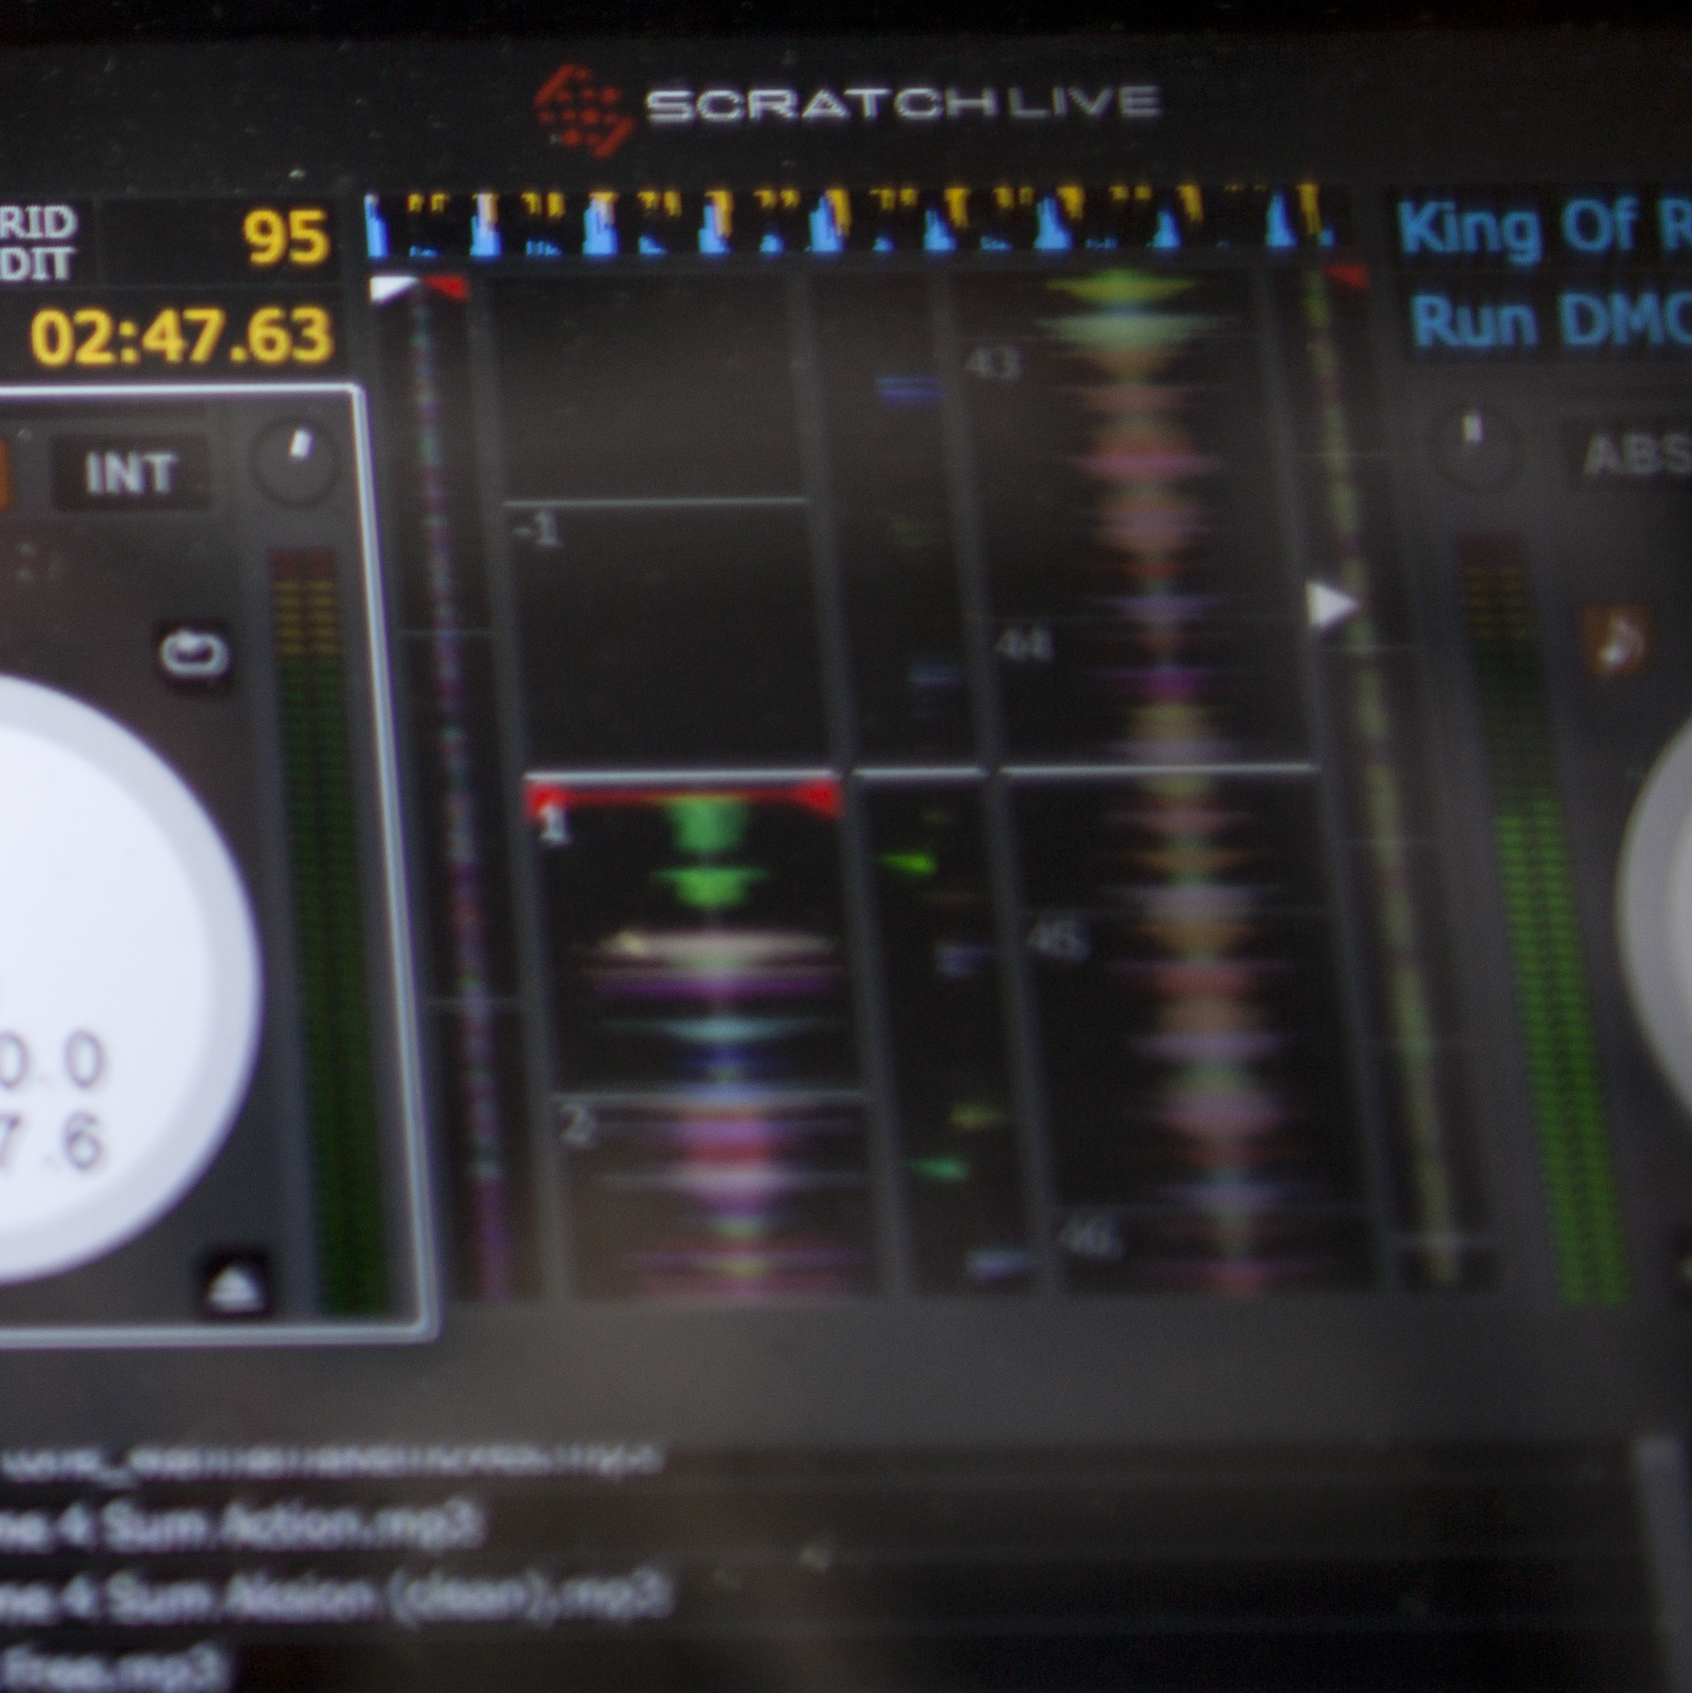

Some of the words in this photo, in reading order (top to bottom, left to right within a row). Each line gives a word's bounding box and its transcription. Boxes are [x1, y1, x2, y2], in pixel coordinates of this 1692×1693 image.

[243, 209, 331, 266] 95
[1396, 199, 1543, 267] King
[1560, 197, 1639, 252] Of
[30, 307, 333, 366] 02:47.63
[1410, 293, 1539, 348] Run
[85, 451, 178, 495] INT
[101, 1498, 209, 1554] Sum
[104, 1568, 214, 1624] Sum
